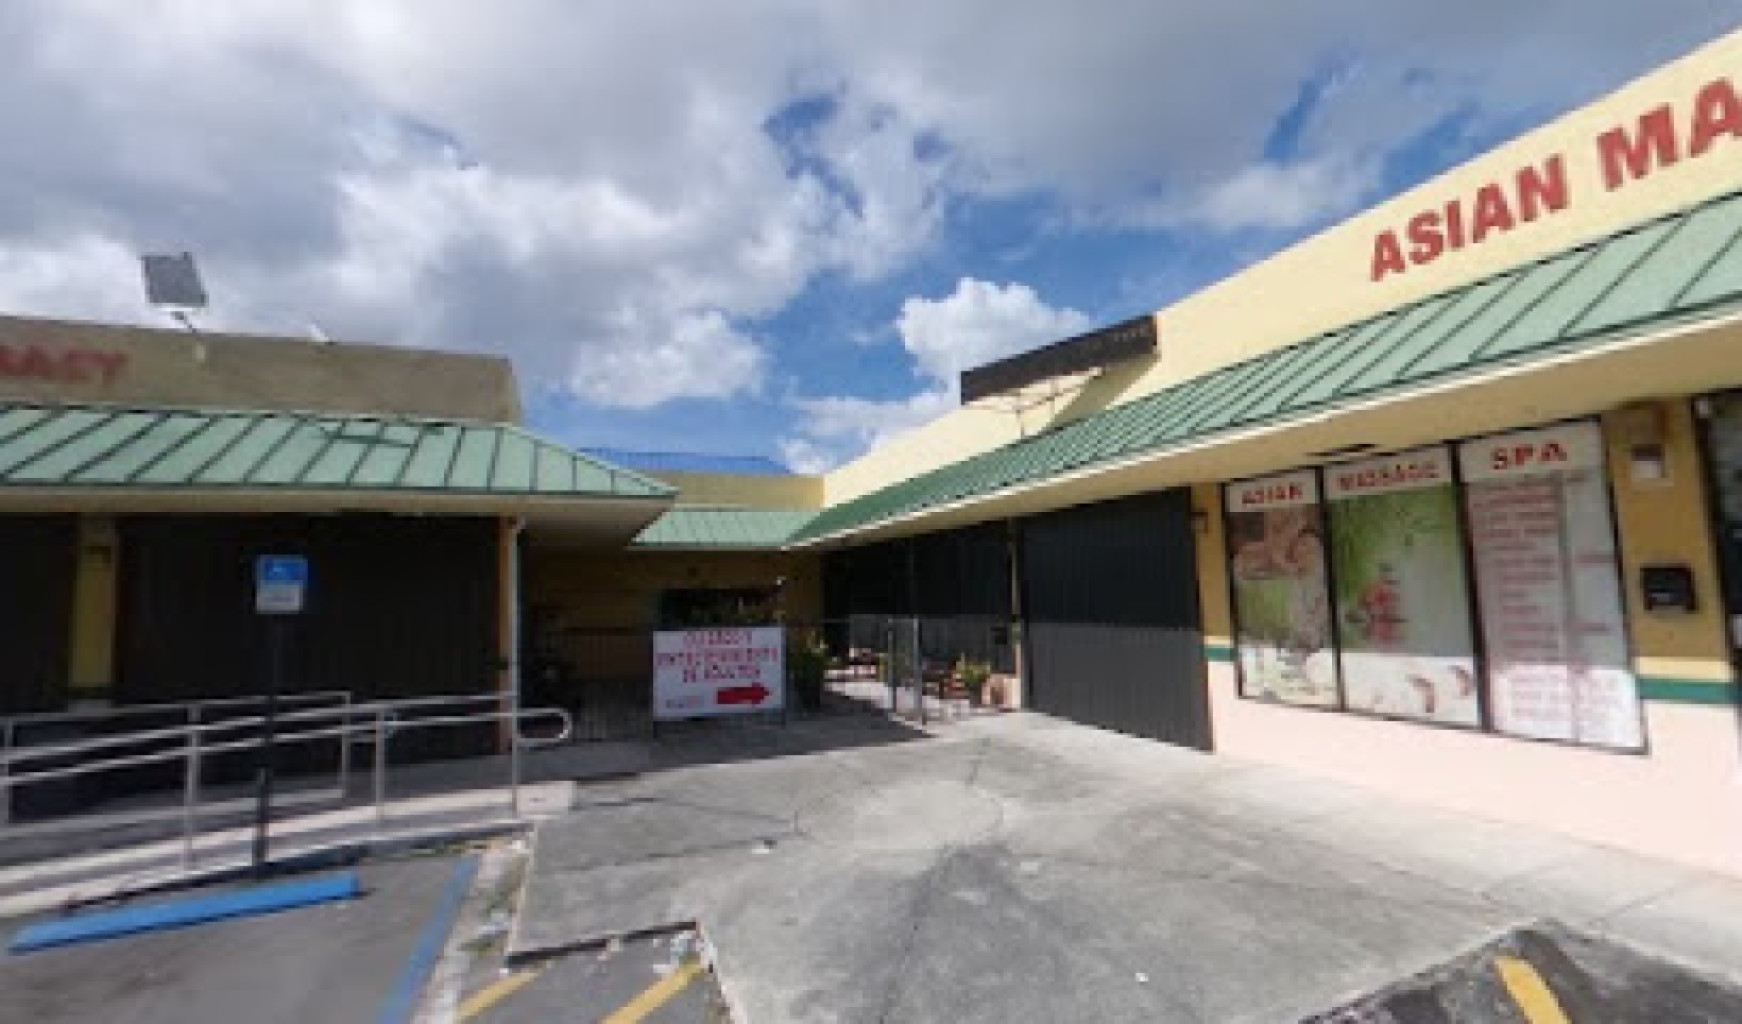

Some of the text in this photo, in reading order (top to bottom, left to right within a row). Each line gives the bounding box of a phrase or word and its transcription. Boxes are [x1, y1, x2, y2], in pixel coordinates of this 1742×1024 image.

[1369, 76, 1742, 282] ASIAN MA
[1241, 482, 1303, 504] ASIAN
[1336, 460, 1440, 492] MASSAGE
[1491, 442, 1568, 471] SPA
